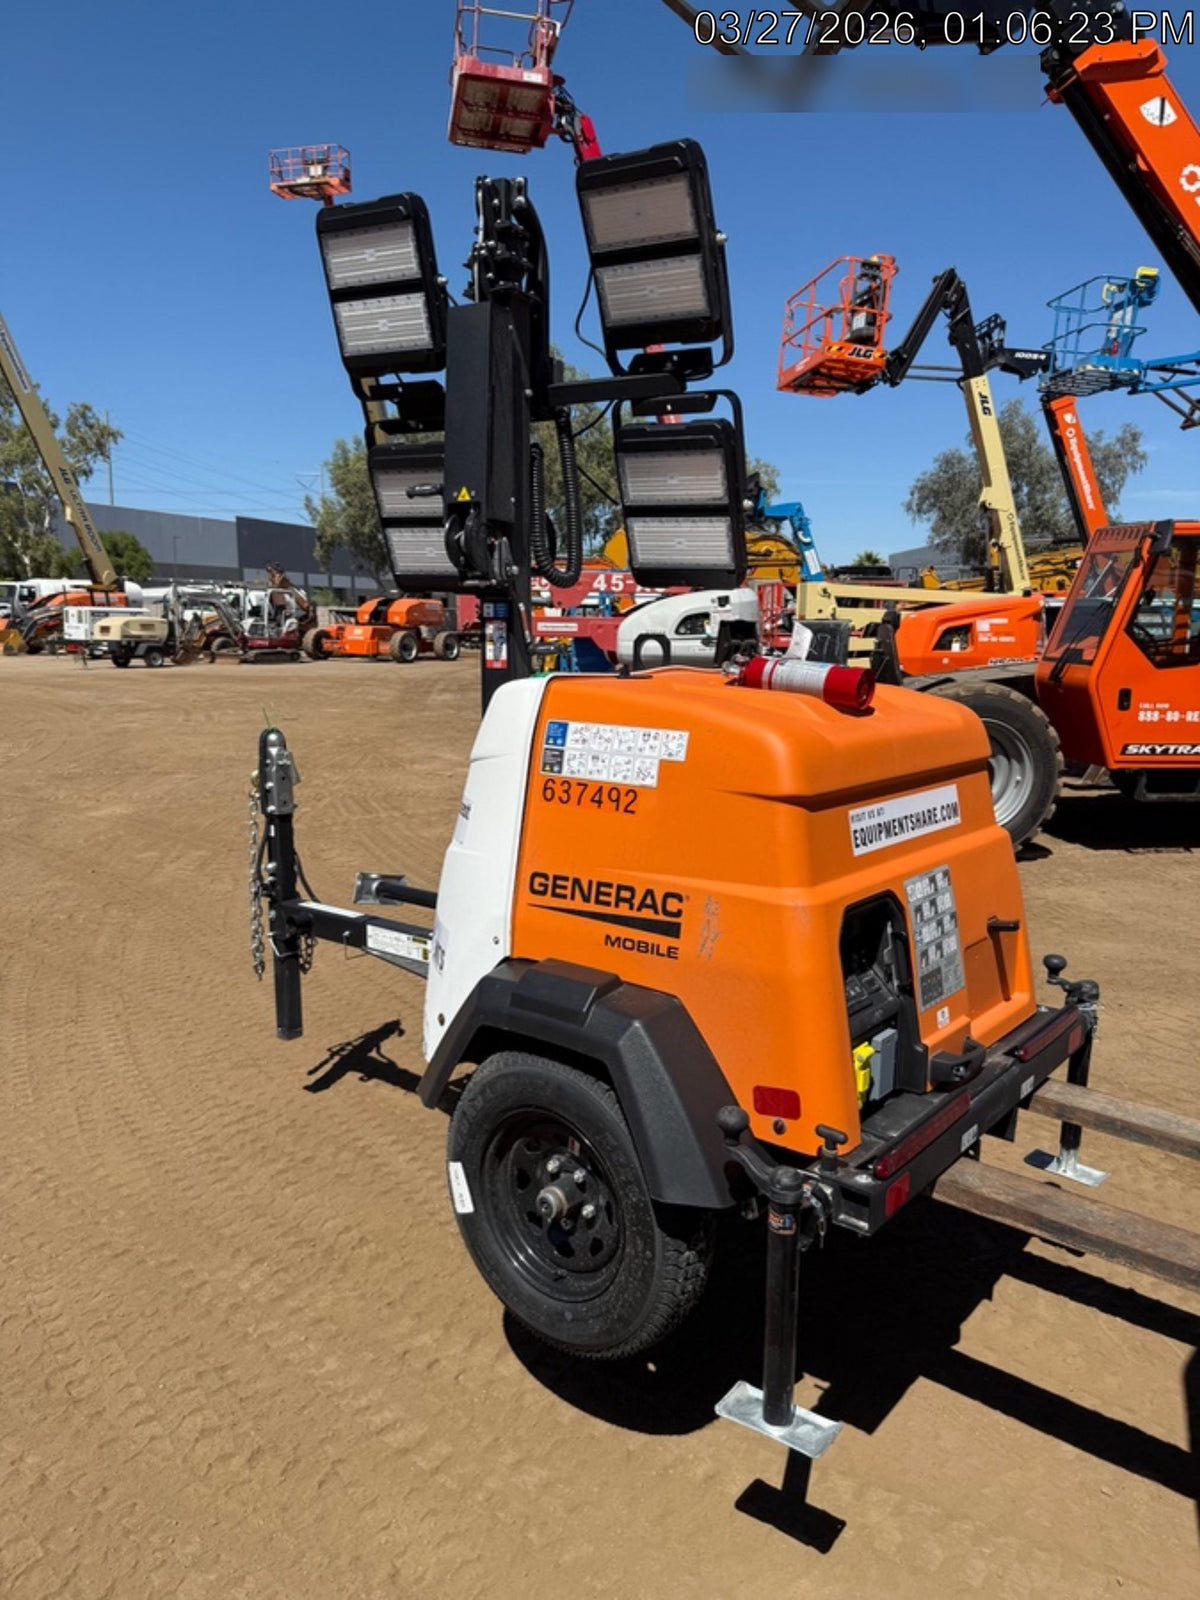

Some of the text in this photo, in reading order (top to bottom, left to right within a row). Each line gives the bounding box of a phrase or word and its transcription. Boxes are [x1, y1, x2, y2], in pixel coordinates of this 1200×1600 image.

[847, 346, 874, 359] JLG
[978, 391, 992, 417] JLG
[58, 466, 72, 485] JLG
[542, 778, 638, 815] 637492
[853, 801, 959, 849] EQUIPMENTSHARE.COM
[529, 870, 684, 918] GENERAC
[604, 934, 680, 960] MOBILE
